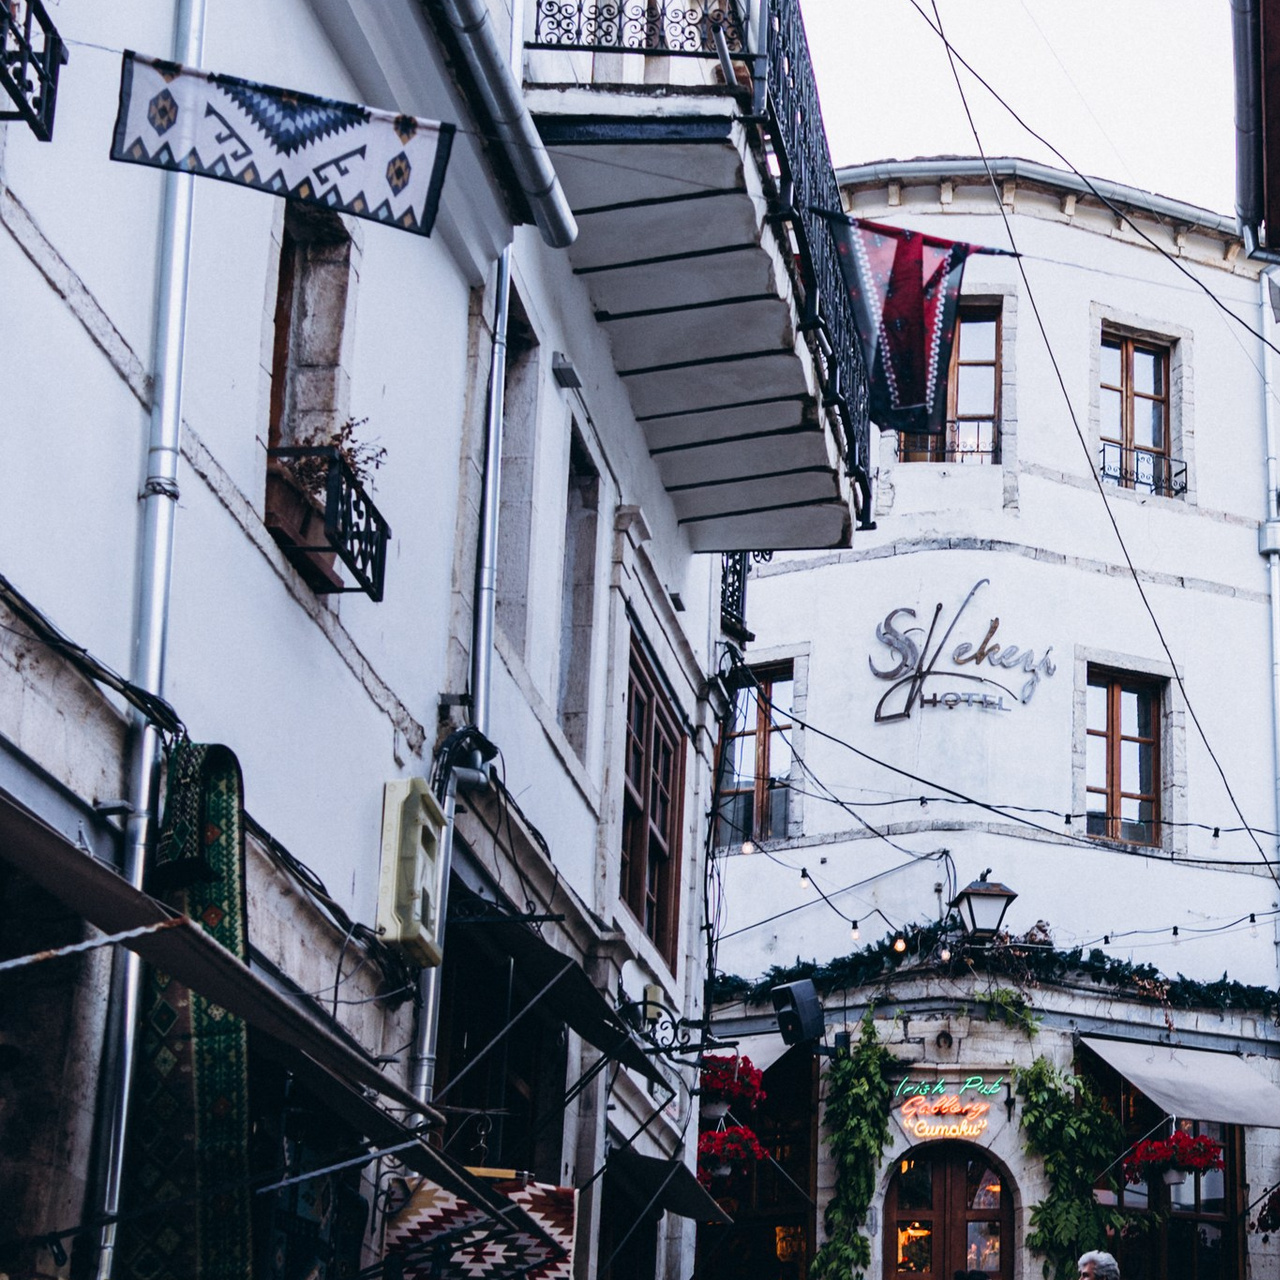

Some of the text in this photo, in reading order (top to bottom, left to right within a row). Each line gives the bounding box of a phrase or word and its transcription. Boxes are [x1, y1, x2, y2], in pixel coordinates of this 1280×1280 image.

[920, 692, 1012, 712] HOTEL
[895, 1075, 1004, 1097] Irish Pub
[901, 1095, 990, 1120] Gallery
